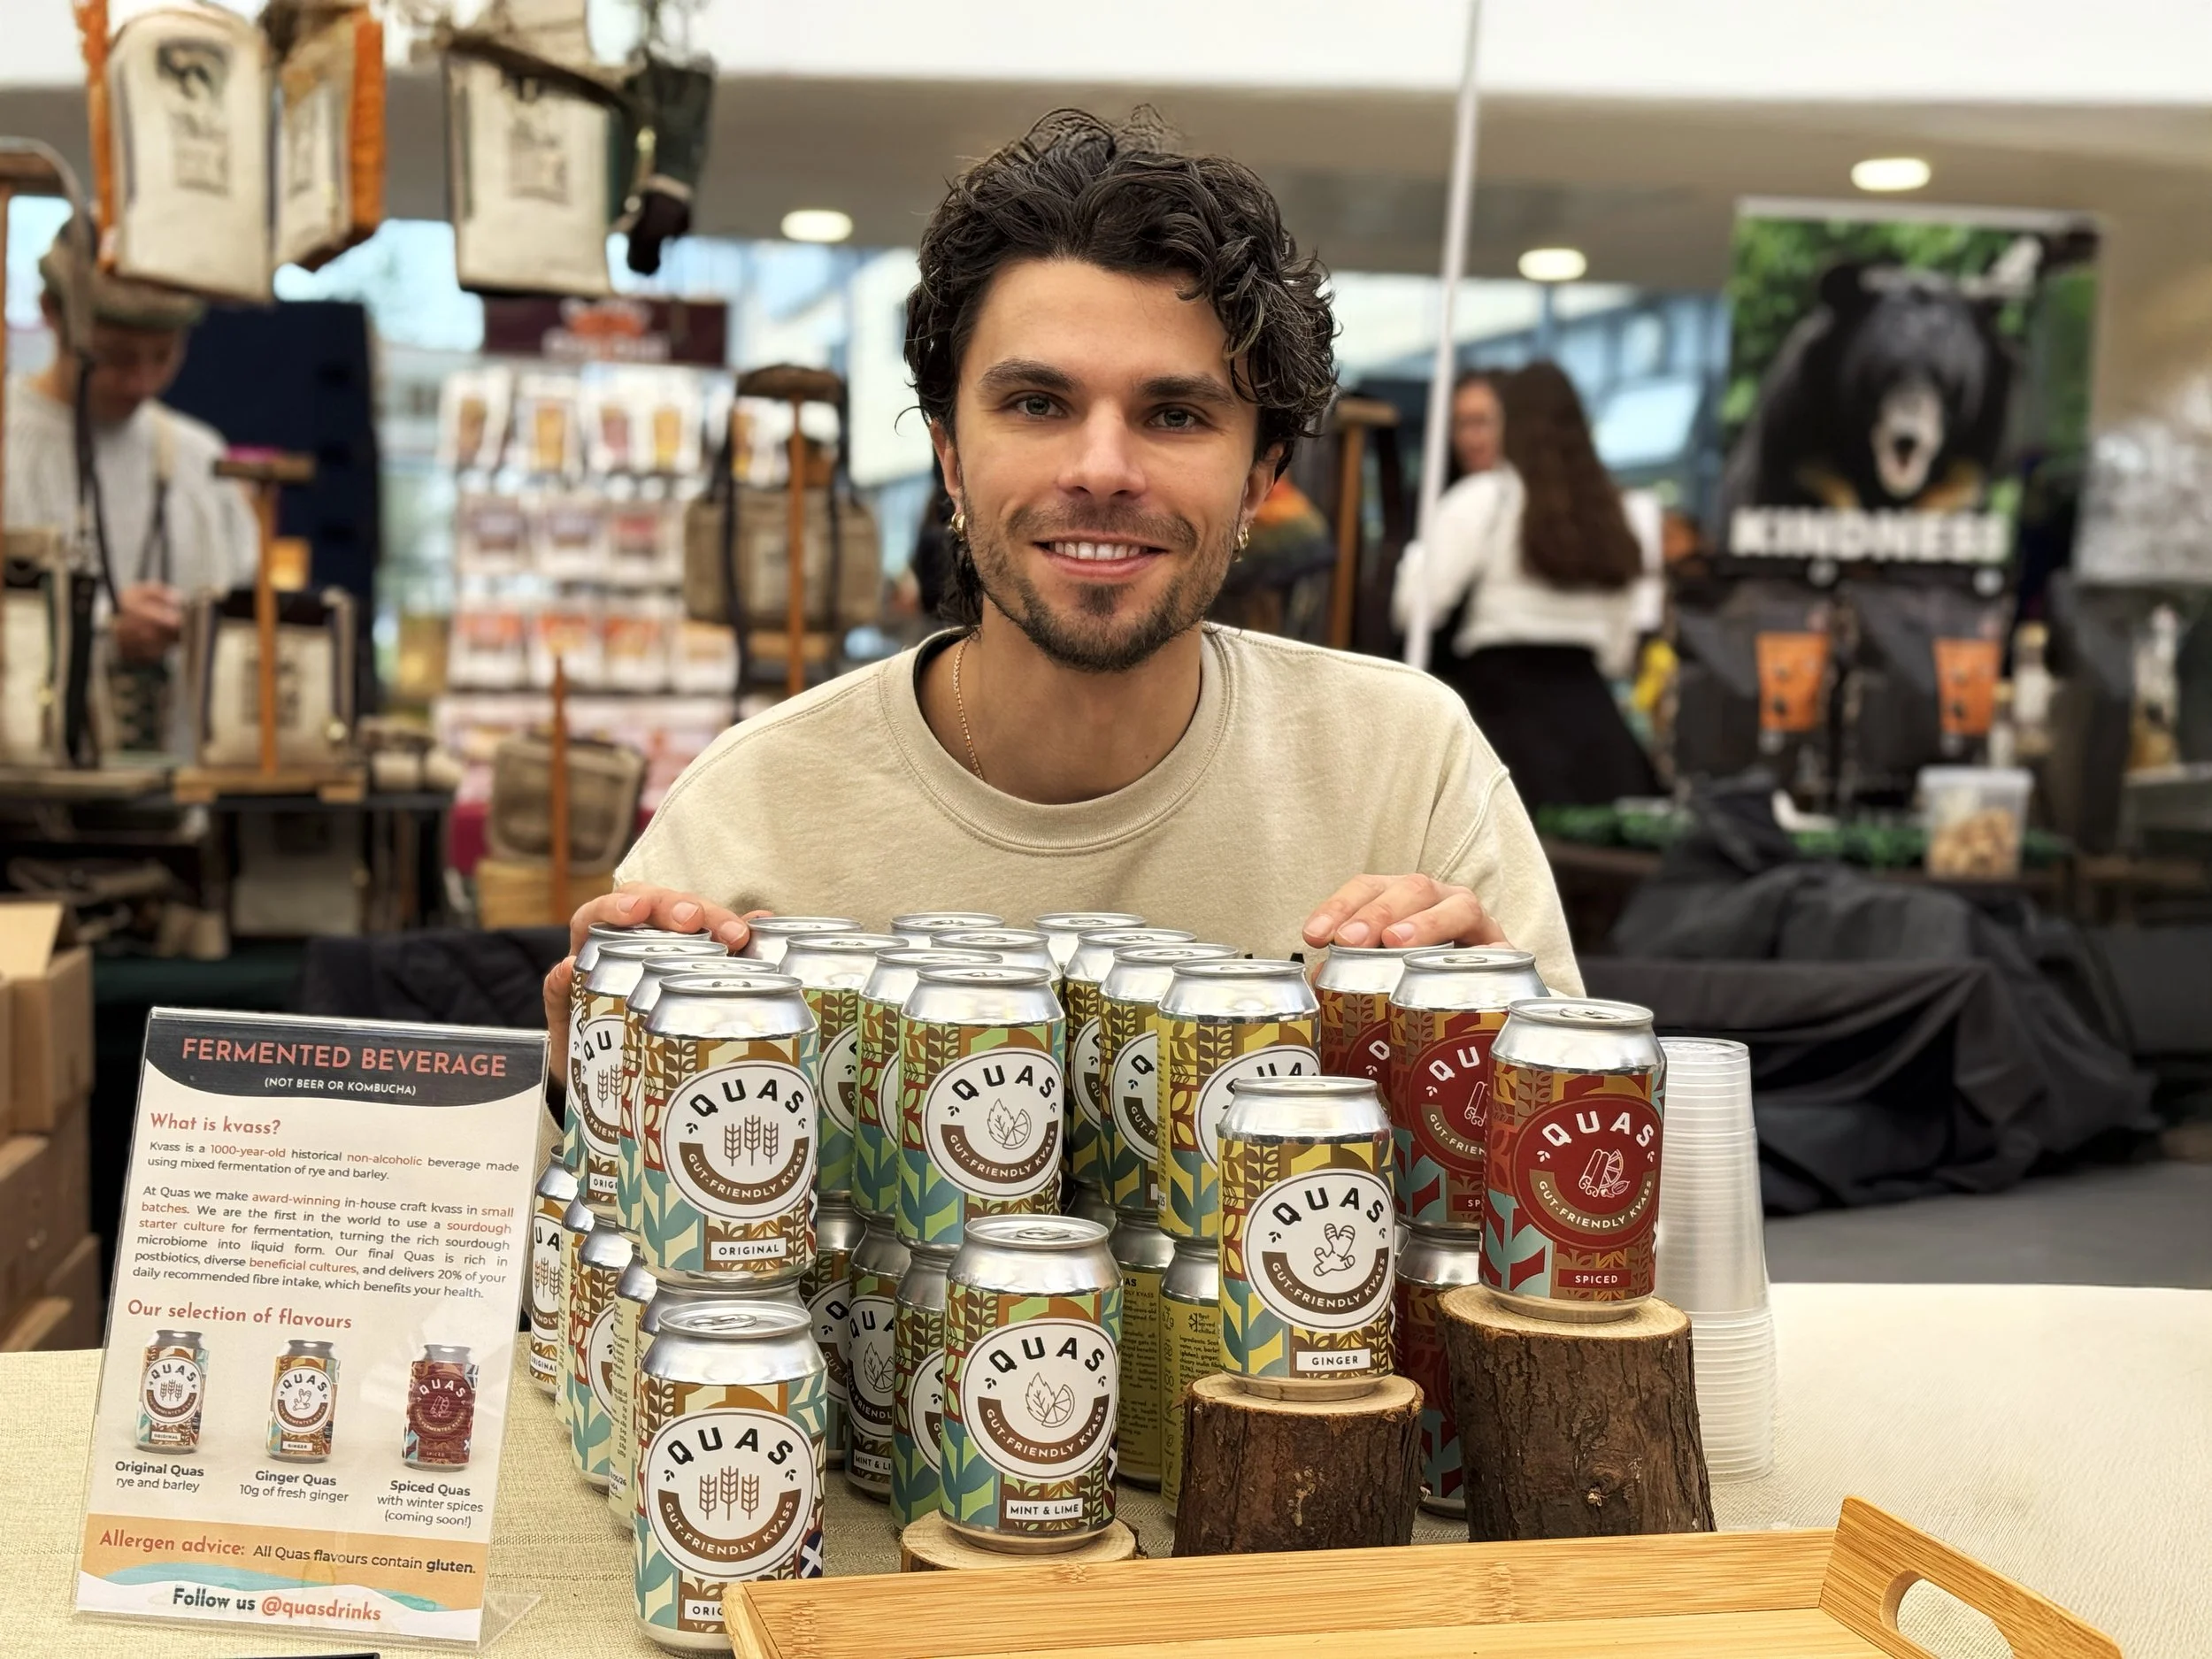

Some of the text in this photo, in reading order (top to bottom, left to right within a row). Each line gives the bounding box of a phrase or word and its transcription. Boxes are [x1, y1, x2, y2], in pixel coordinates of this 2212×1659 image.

[182, 1038, 507, 1077] FERMENTED BEVERAGE
[584, 1031, 623, 1061] QU
[1428, 1046, 1480, 1081] QU
[265, 1077, 417, 1096] (NOT BEER OR KOMBUCHA)
[689, 1079, 805, 1118] QUAS
[951, 1064, 1056, 1101] QUAS
[150, 1112, 281, 1135] What is kvass?
[1429, 1113, 1485, 1156] GUT-FRIEN
[1542, 1110, 1655, 1148] QUAS
[147, 1156, 390, 1182] using mixed fermentation of rye and barley.
[149, 1141, 520, 1172] Kvass is a 1000-year-old historical non-alcoholic beverage made
[949, 1130, 1056, 1178] GUT-FRIENDLY KVASS
[688, 1148, 805, 1199] GUT-FRIENDLY KVASS
[142, 1186, 514, 1218] At Quas we make award-winning in-house craft kvass in small
[1272, 1187, 1384, 1226] QUAS
[1539, 1179, 1653, 1229] GUT-FRIENDLY KVASS
[142, 1202, 511, 1236] batches. We are the first in the world to use a sourdough
[136, 1233, 508, 1267] microbiome into liquid form. Our final Quas is rich in
[138, 1219, 511, 1253] starter culture for fermentation, turning the rich sourdough
[718, 1244, 780, 1256] ORIGINAL
[132, 1266, 484, 1299] daily recommended fibre intake, which benefits your health.
[134, 1251, 507, 1285] postbiotics, diverse beneficial cultures, and delivers 20% of your
[1271, 1256, 1386, 1309] GUT-FRIENDLY KVASS
[1575, 1273, 1618, 1284] SPICED
[127, 1299, 352, 1329] Our selection of flavours
[988, 1336, 1105, 1373] QUAS
[1311, 1356, 1359, 1365] GINGER
[150, 1363, 196, 1382] QUAS
[282, 1373, 327, 1392] QUAS
[419, 1379, 466, 1398] QUAS
[667, 1426, 794, 1466] QUAS
[987, 1405, 1104, 1458] GUT-FRIENDLY KVASS
[115, 1461, 204, 1478] Original Quas
[255, 1470, 337, 1487] Ginger Quas
[116, 1478, 201, 1494] rye and barley
[239, 1484, 349, 1504] 10g of fresh ginger
[389, 1479, 471, 1497] Spiced Quas
[377, 1494, 484, 1513] with winter spices
[384, 1509, 472, 1530] (coming soon!)
[1010, 1503, 1079, 1516] MINT & LIME
[664, 1501, 793, 1555] GUT-FRIENDLY KVASS
[98, 1529, 476, 1574] Allergen advice: All Quas flavours contain gluten.
[173, 1589, 381, 1621] Follow us @quasdrinks
